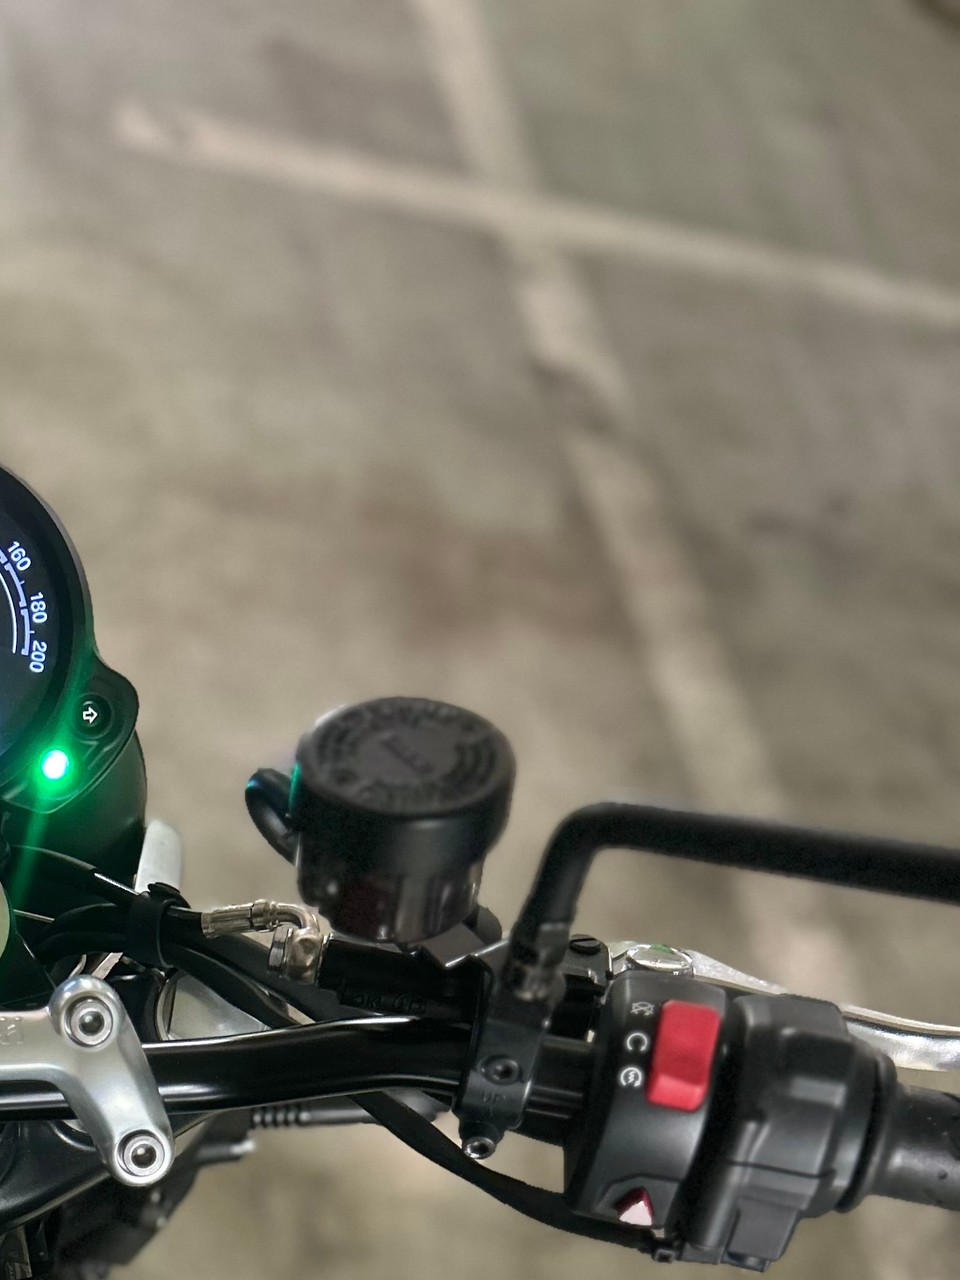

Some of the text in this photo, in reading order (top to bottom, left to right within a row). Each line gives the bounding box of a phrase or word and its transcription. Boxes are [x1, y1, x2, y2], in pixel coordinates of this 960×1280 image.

[7, 541, 32, 571] 160
[30, 591, 48, 624] 180
[29, 639, 48, 673] 200
